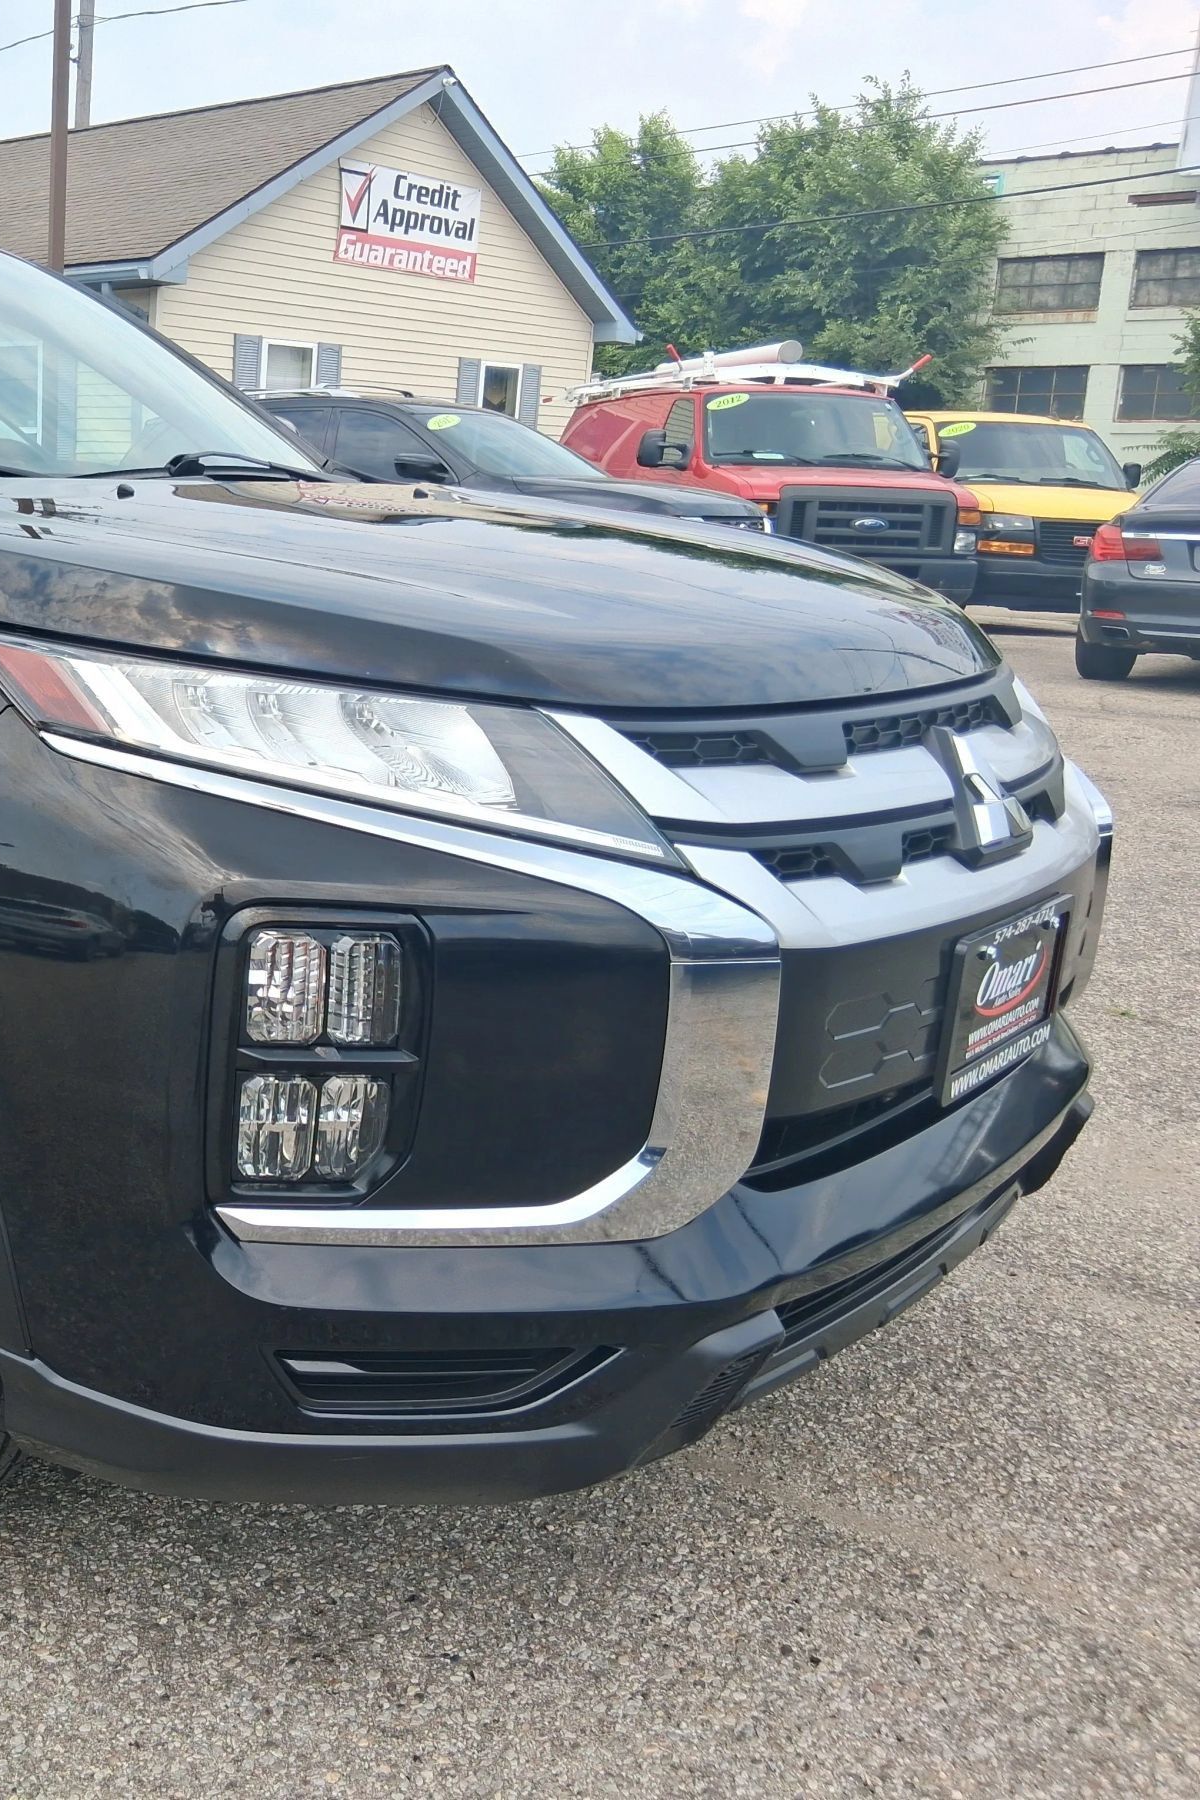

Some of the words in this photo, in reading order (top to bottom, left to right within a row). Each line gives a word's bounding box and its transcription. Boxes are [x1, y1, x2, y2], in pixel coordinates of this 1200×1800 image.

[393, 174, 462, 212] Credit
[373, 199, 476, 242] Approval
[339, 234, 473, 279] Guaranteed
[715, 394, 743, 409] 2012
[993, 907, 1055, 945] 574-287-4714
[976, 940, 1042, 1007] Omari
[968, 997, 1040, 1046] WWW.OMARIAUTO.COM
[950, 1024, 1051, 1099] WWW.OMARIAUTO.COM
